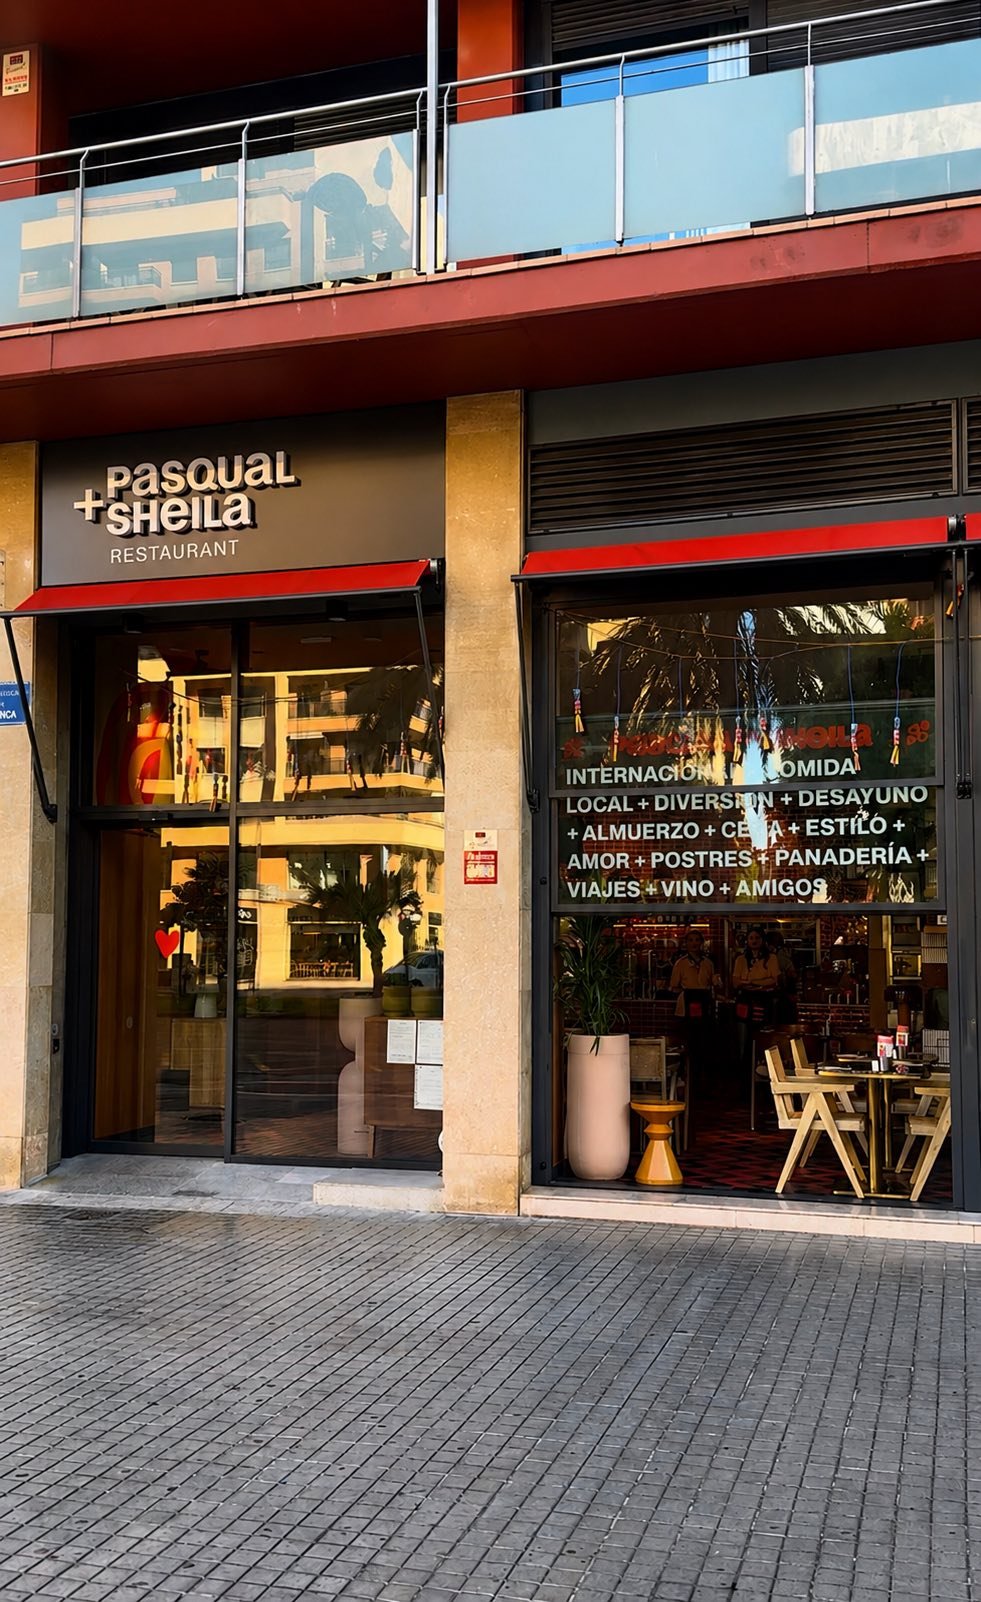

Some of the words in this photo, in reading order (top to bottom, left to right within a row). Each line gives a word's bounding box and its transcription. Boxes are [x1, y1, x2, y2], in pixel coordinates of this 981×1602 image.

[110, 539, 239, 564] RESTAURANT
[566, 762, 741, 785] INTERNACIO
[766, 757, 856, 778] OMIDA
[566, 795, 634, 814] LOCAL
[799, 785, 929, 807] DESAYUNO
[582, 821, 700, 841] ALMUERZO
[721, 819, 784, 839] CEA
[567, 852, 630, 870] AMOR
[651, 850, 753, 869] POSTRES
[775, 842, 913, 867] PANADERÍA
[567, 880, 641, 898] VIAJES
[660, 879, 715, 897] VINO
[735, 877, 827, 897] AMIGOS
